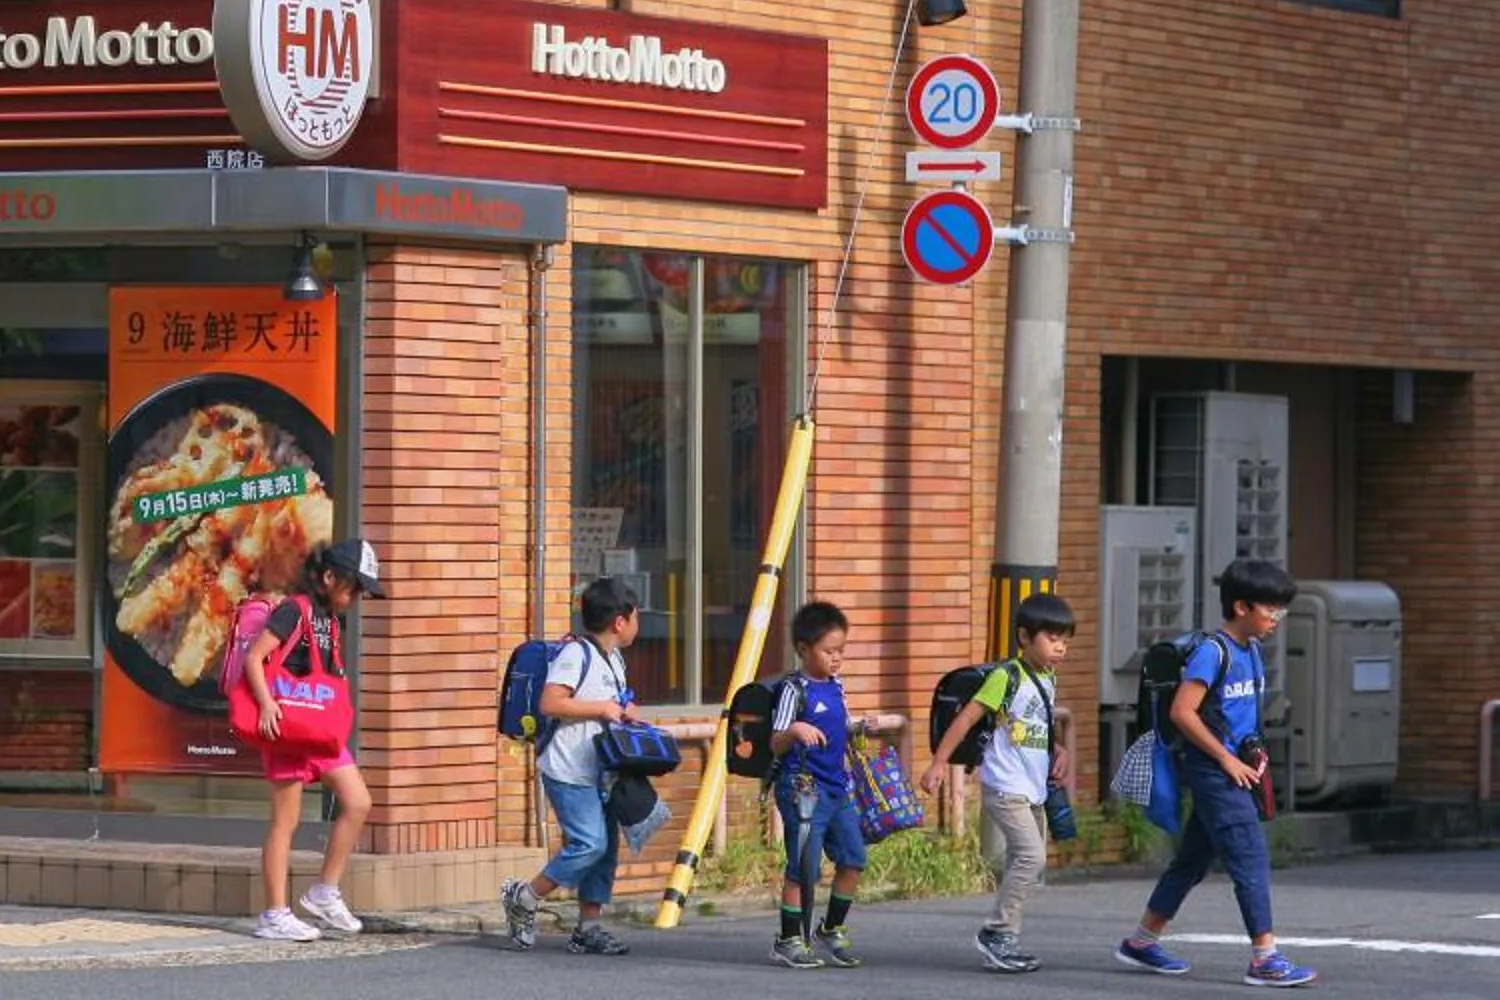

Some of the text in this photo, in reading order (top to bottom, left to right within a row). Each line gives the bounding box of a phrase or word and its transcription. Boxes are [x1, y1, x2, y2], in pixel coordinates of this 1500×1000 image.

[277, 3, 360, 83] HM
[531, 22, 725, 93] HottoMotto
[283, 96, 353, 141] ほっともっと
[929, 83, 977, 122] 20
[207, 149, 264, 169] 西院店
[162, 310, 320, 353] 海鮮天丼
